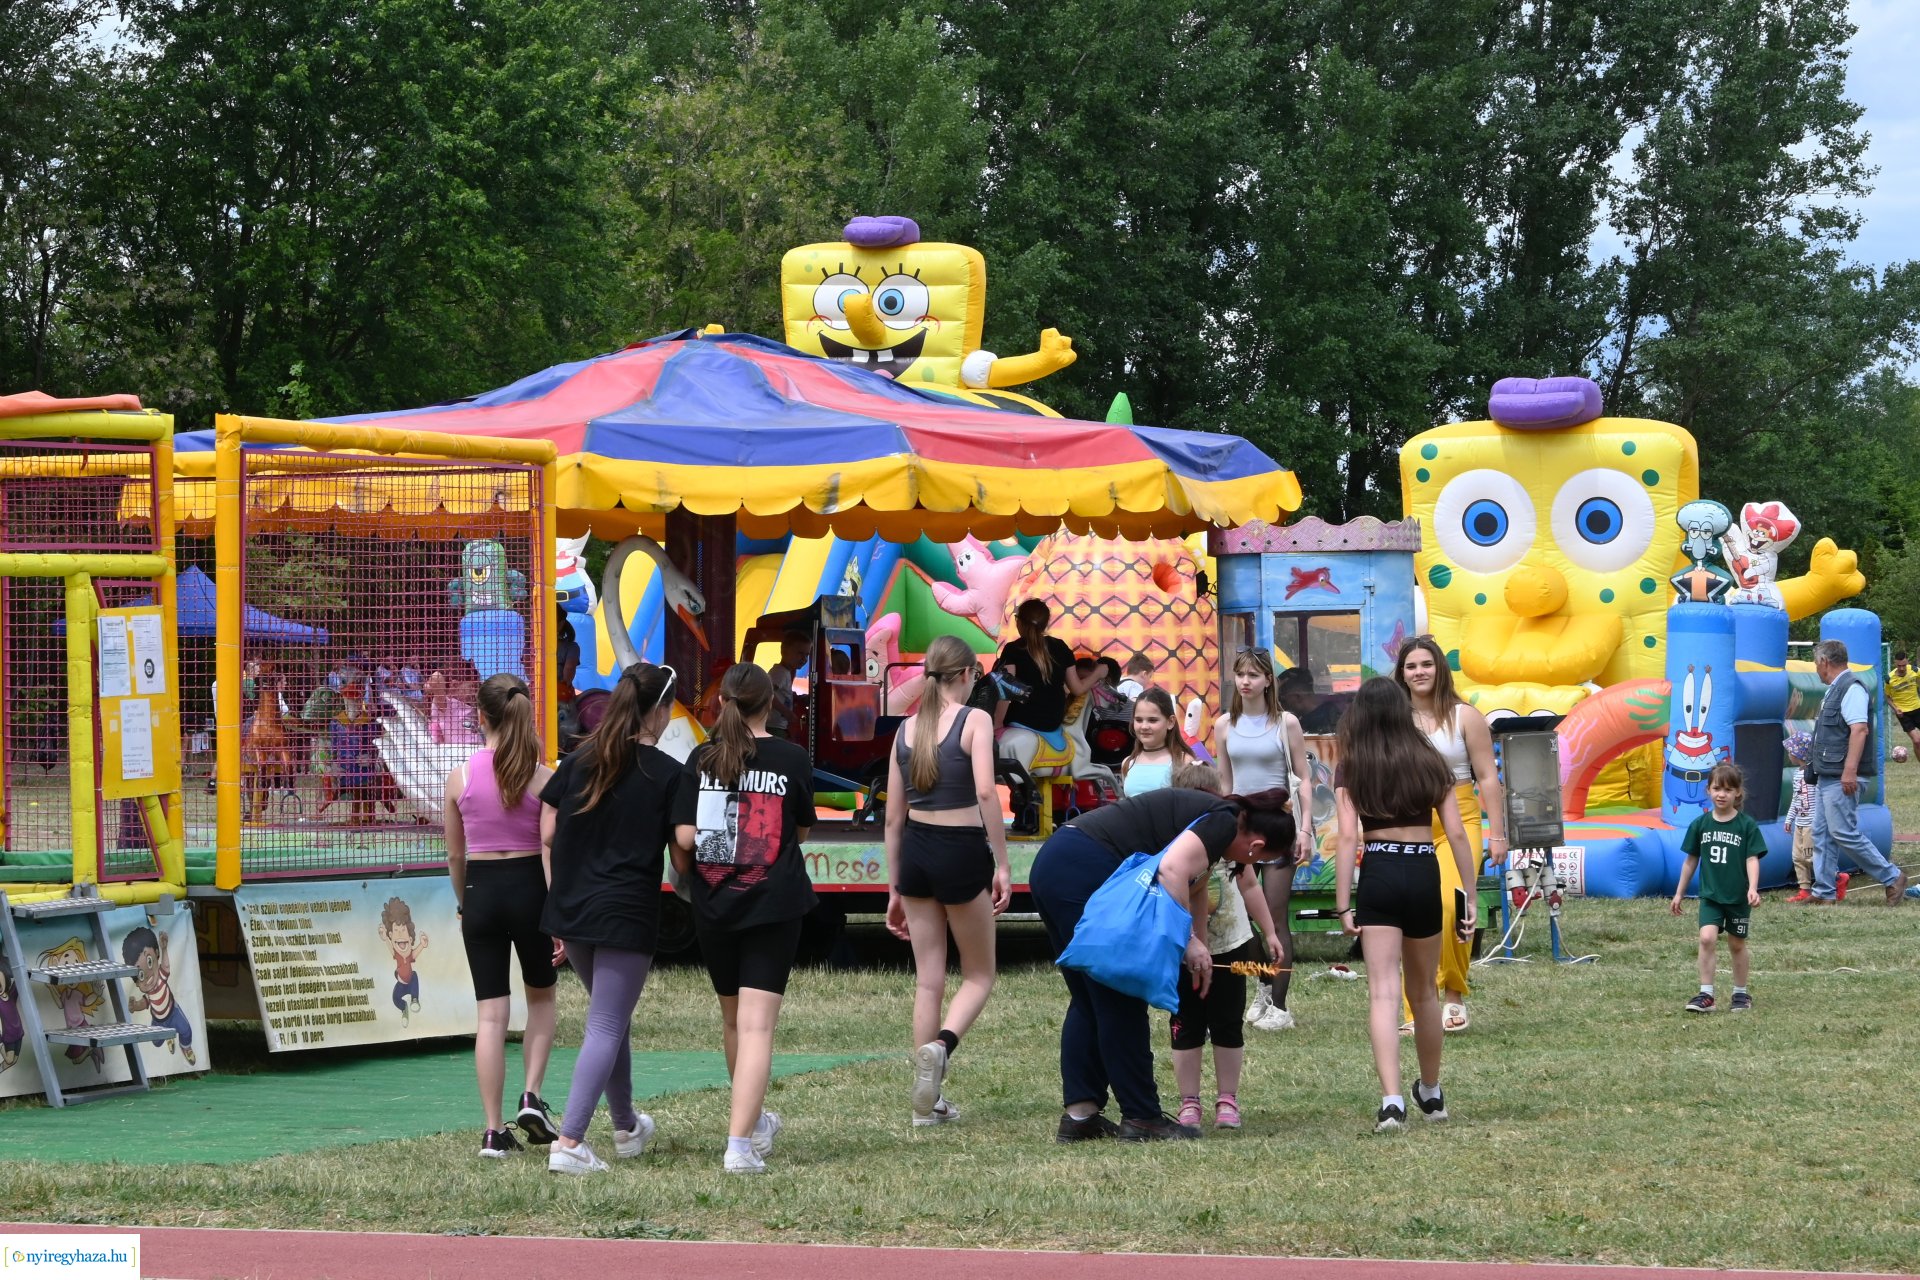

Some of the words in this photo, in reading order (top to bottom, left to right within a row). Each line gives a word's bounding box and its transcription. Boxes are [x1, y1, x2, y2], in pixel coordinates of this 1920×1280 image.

[699, 770, 728, 790] LL
[738, 770, 788, 796] MURS
[1712, 831, 1742, 847] ANGELES
[1364, 842, 1401, 853] NIKE
[1709, 845, 1728, 864] 91
[804, 852, 880, 882] Mese
[1736, 925, 1746, 934] 91
[303, 1014, 311, 1027] 14
[310, 1030, 324, 1043] perc
